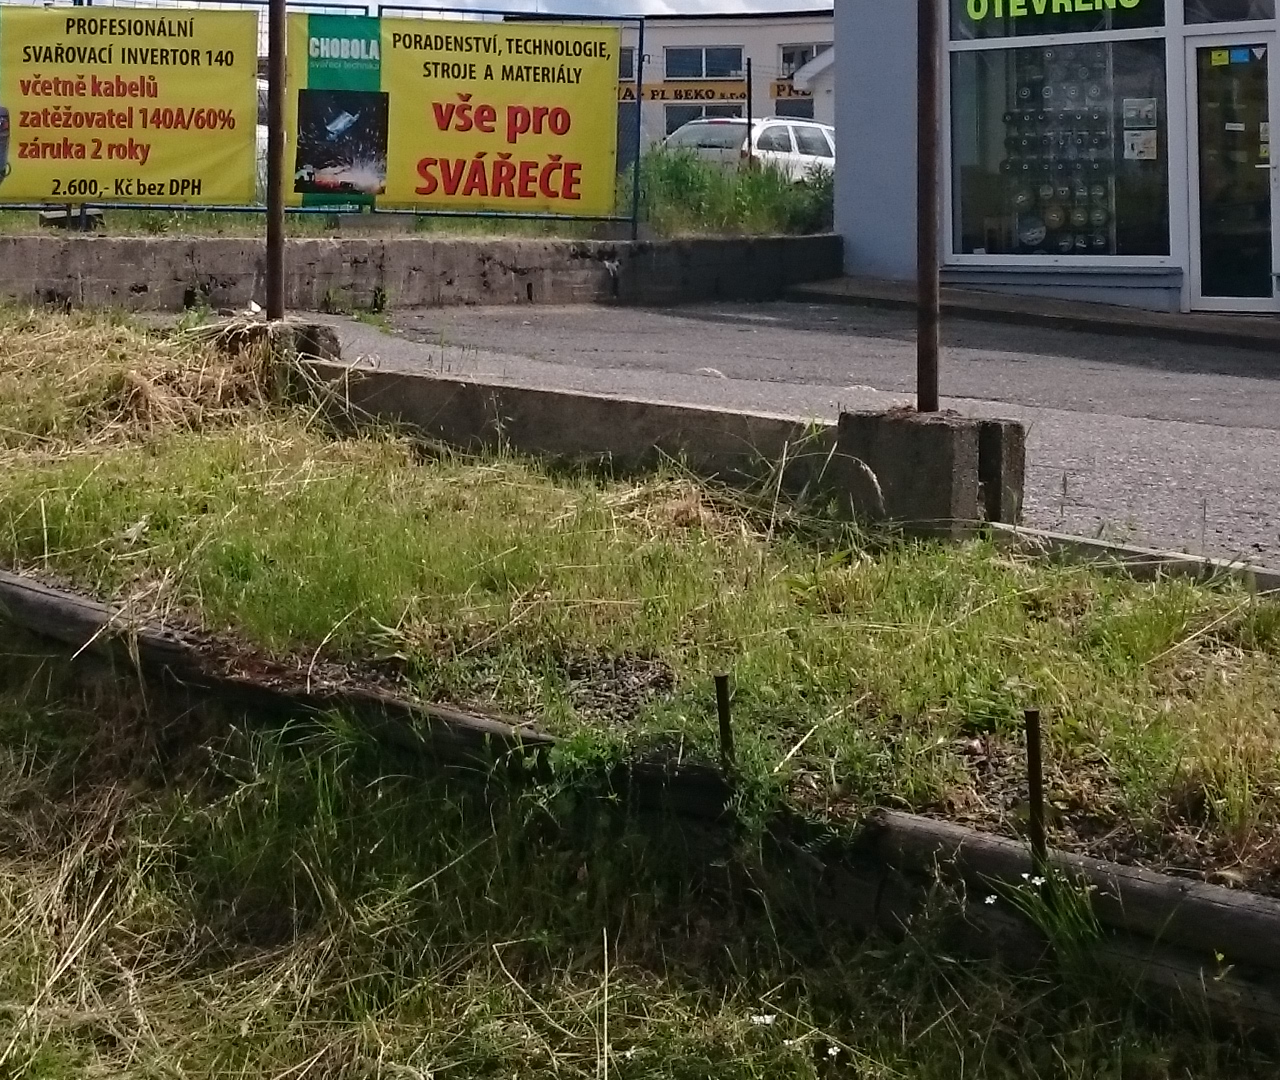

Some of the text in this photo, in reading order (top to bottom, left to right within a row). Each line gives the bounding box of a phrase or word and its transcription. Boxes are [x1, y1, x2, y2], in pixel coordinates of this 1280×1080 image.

[65, 17, 195, 37] PROFESIONÁLNÍ
[22, 43, 235, 67] SVAŘOVACÍ INVERTOR 140
[309, 37, 380, 60] CHOBOLA
[392, 32, 612, 60] PORADENSTVÍ, TECHNOLOGIE,
[422, 61, 582, 84] STROJE A MATERIÁLY
[19, 73, 158, 98] včetně kabelů
[19, 106, 236, 130] zatěžovatel 140A/60%
[431, 92, 571, 144] vše pro
[18, 137, 151, 166] záruka 2 roky
[415, 151, 583, 201] SVÁŘEČE
[51, 178, 202, 199] 2.600,- Kč bez DPH
